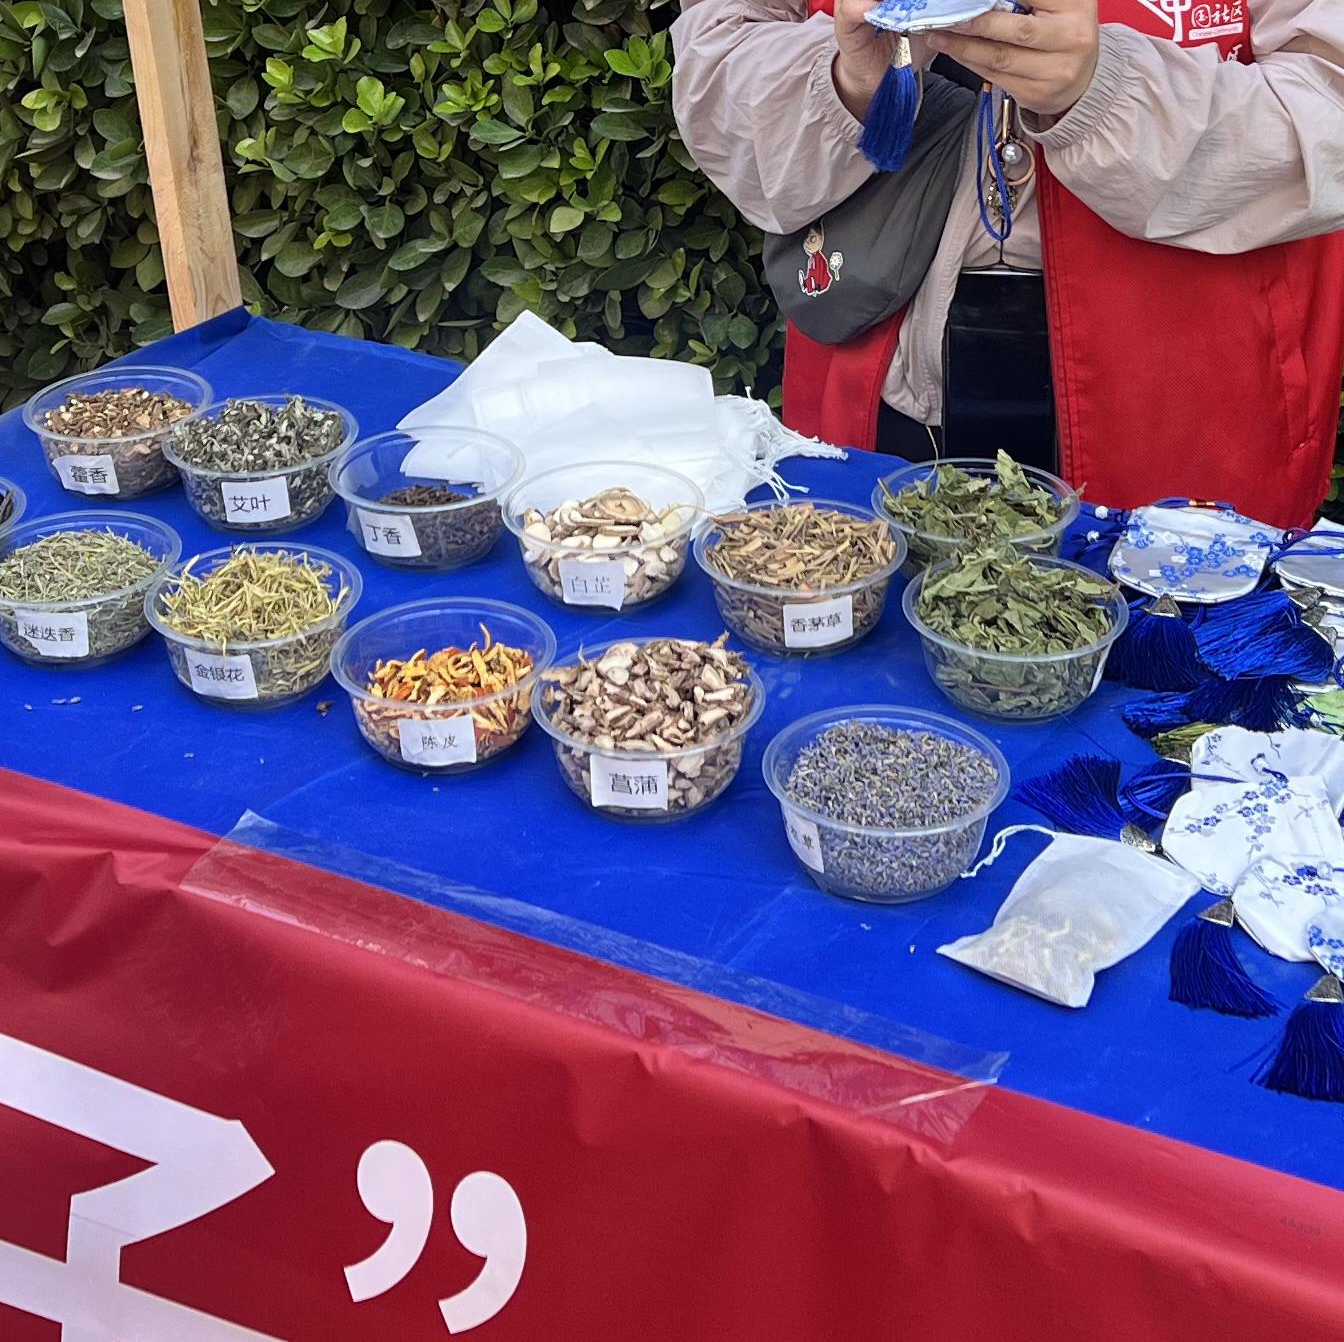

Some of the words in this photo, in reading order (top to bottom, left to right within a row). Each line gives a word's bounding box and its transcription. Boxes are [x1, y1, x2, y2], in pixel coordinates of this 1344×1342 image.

[229, 494, 271, 513] 艾叶
[366, 524, 401, 545] 丁香
[568, 576, 612, 594] 白芷
[24, 623, 76, 642] 迷迭香
[195, 664, 245, 682] 金银花
[421, 733, 459, 751] 陈皮
